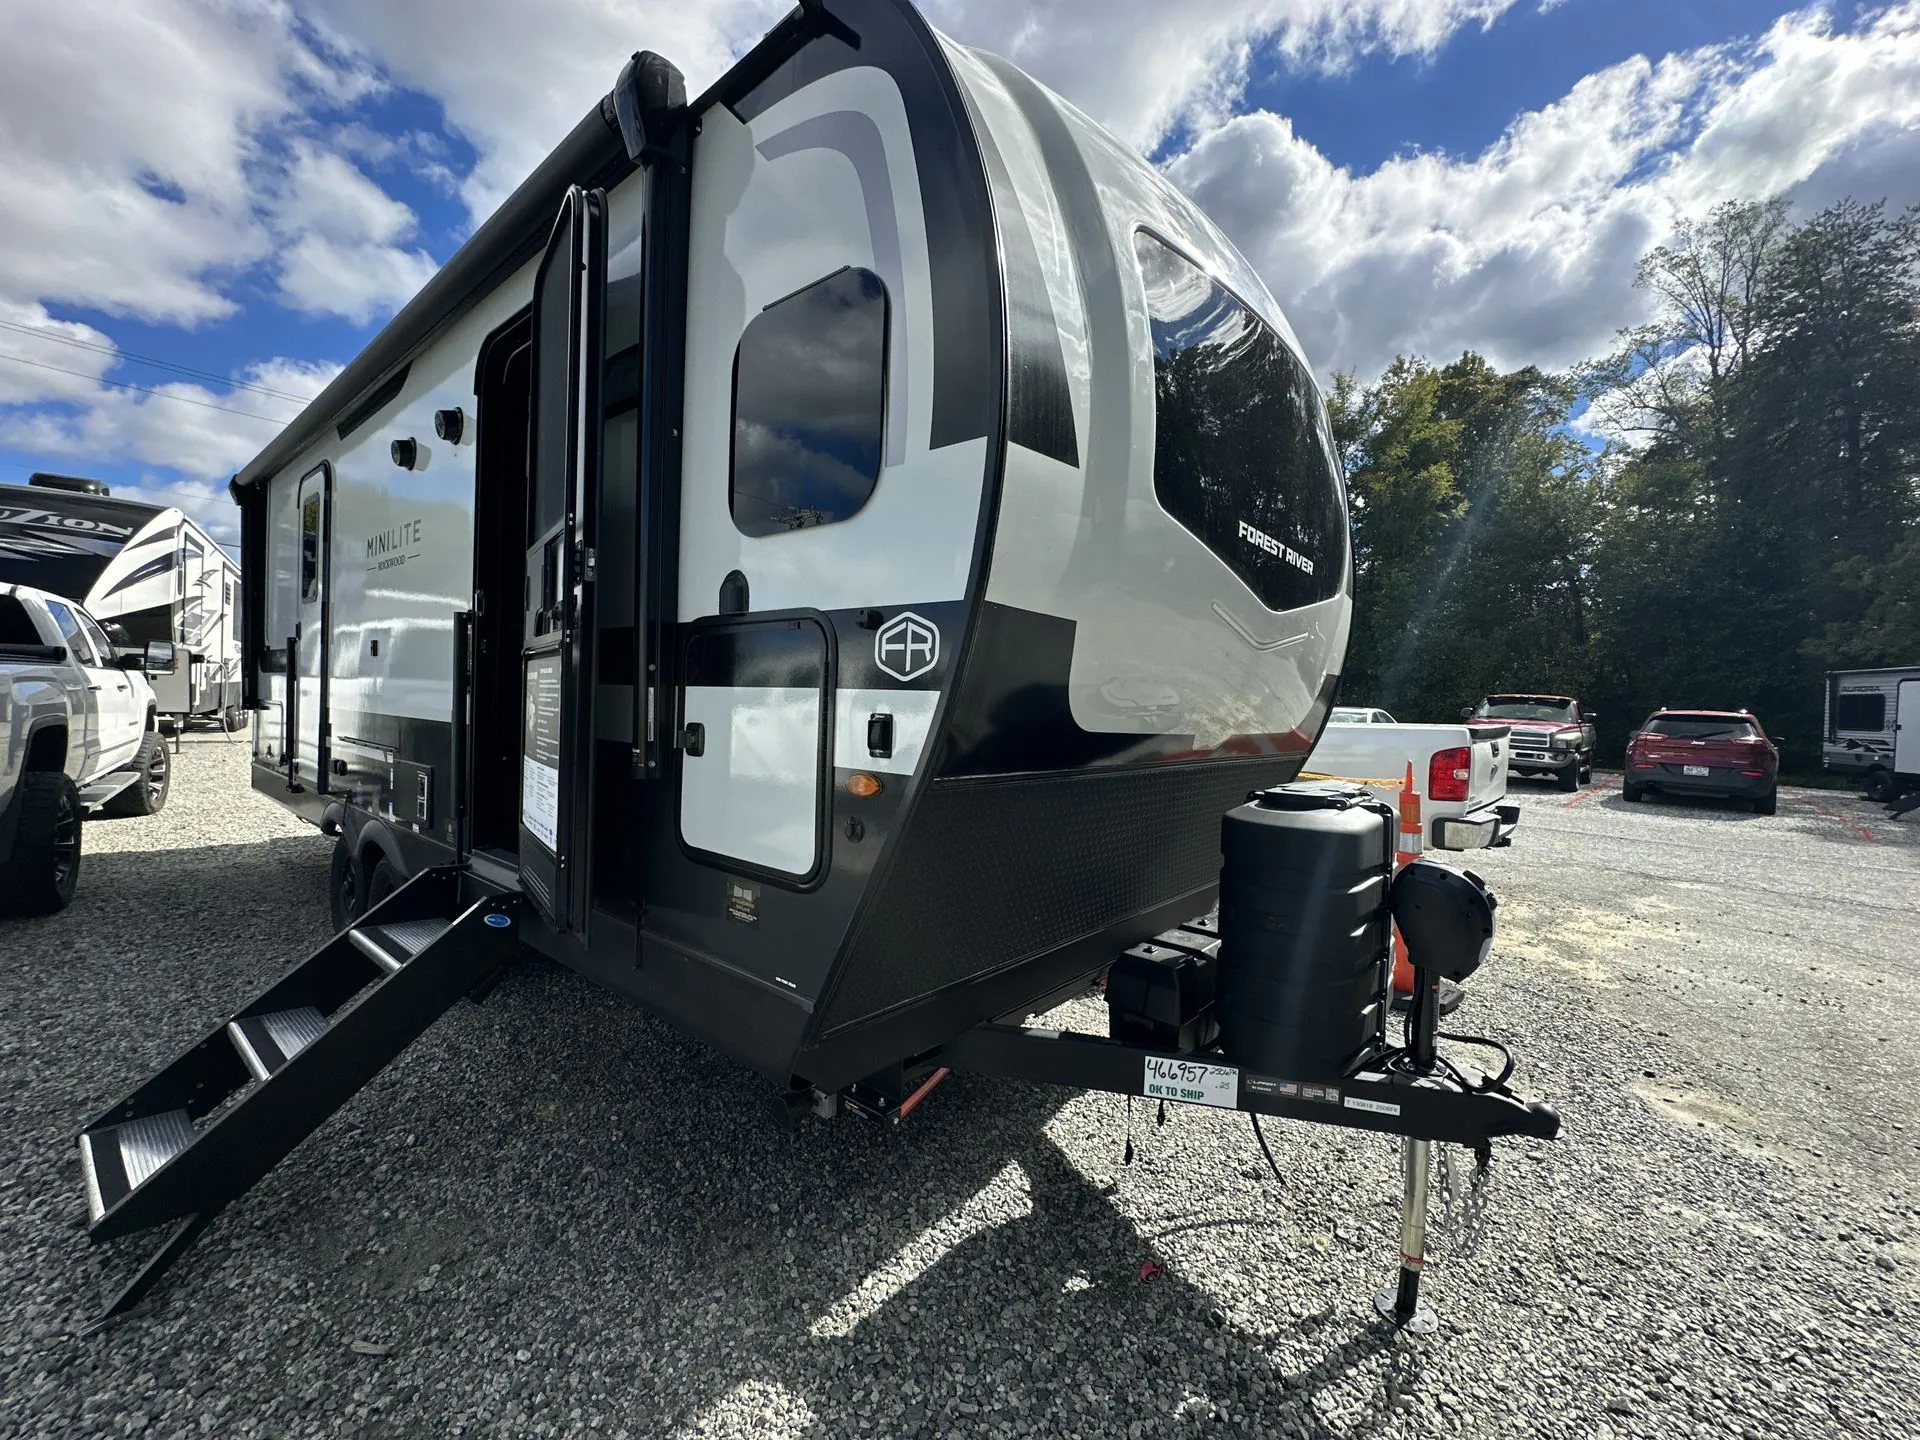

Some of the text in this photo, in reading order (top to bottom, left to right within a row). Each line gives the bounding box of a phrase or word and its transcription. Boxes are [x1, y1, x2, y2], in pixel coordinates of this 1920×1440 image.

[366, 518, 422, 559] MINILITE
[1238, 520, 1314, 575] FOREST RIVER
[1146, 1058, 1209, 1085] 466957
[1148, 1083, 1205, 1100] OK TO SHIP
